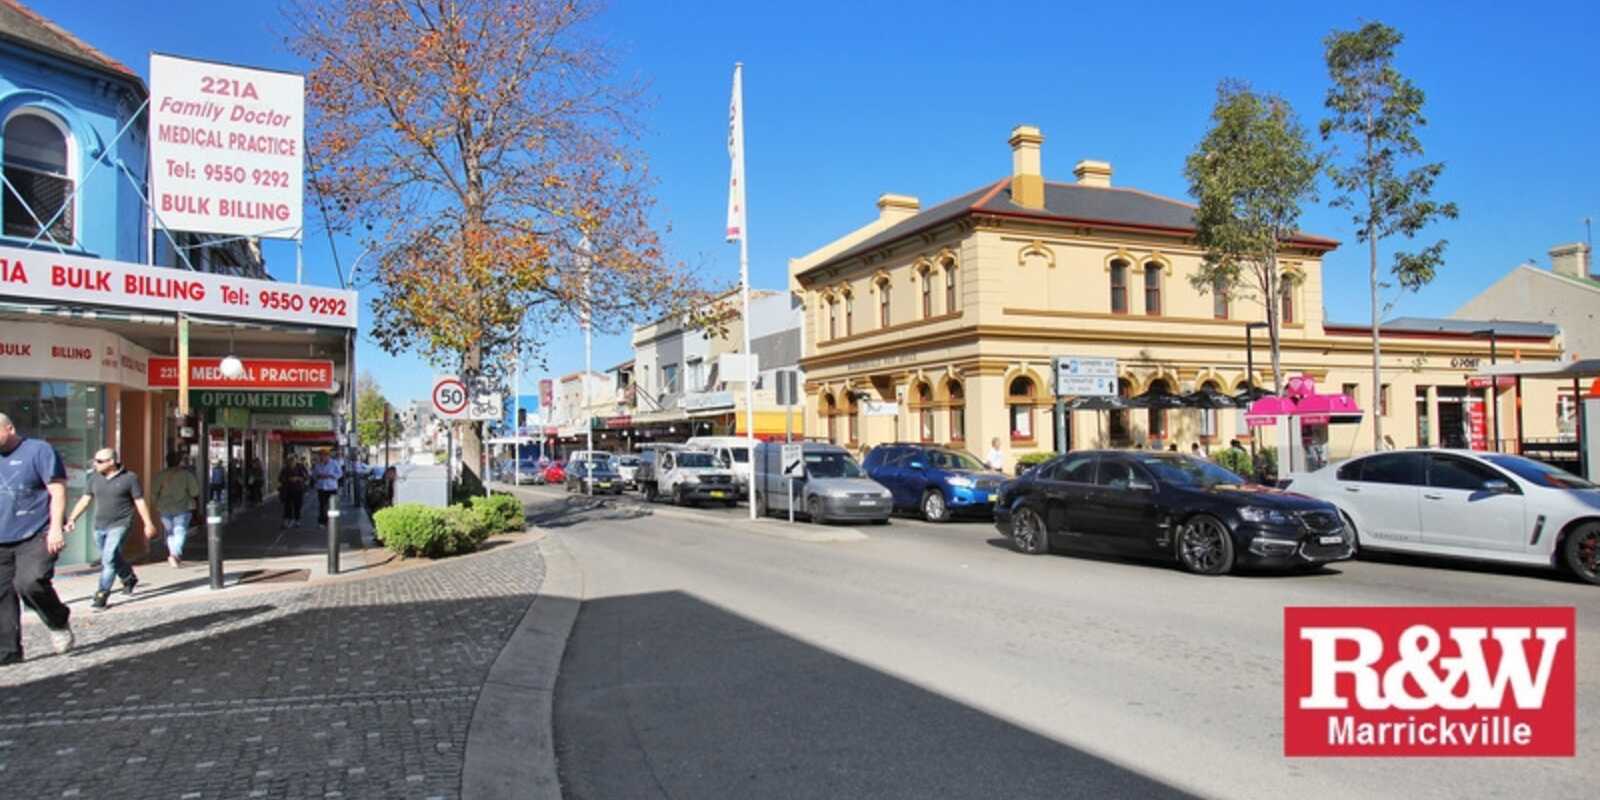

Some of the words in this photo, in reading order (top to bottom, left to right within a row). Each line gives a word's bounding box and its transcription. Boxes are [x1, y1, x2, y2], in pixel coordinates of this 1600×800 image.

[200, 76, 258, 99] 221A
[159, 96, 224, 122] Family
[230, 105, 291, 127] Doctor
[158, 124, 223, 148] MEDICAL
[229, 132, 296, 156] PRACTICE
[166, 160, 196, 178] Tel:
[203, 164, 246, 183] 9550
[251, 169, 289, 187] 9292
[161, 194, 210, 214] BULK
[219, 199, 290, 221] BILLING
[51, 265, 112, 292] BULK
[124, 273, 206, 301] BILLING
[220, 285, 249, 306] Tel:
[259, 290, 303, 311] 9550
[309, 296, 347, 316] 9292
[51, 346, 91, 360] BILLING
[160, 367, 178, 379] 221
[260, 368, 327, 382] PRACTICE
[201, 392, 316, 408] OPTOMETRIST
[441, 389, 463, 404] 50
